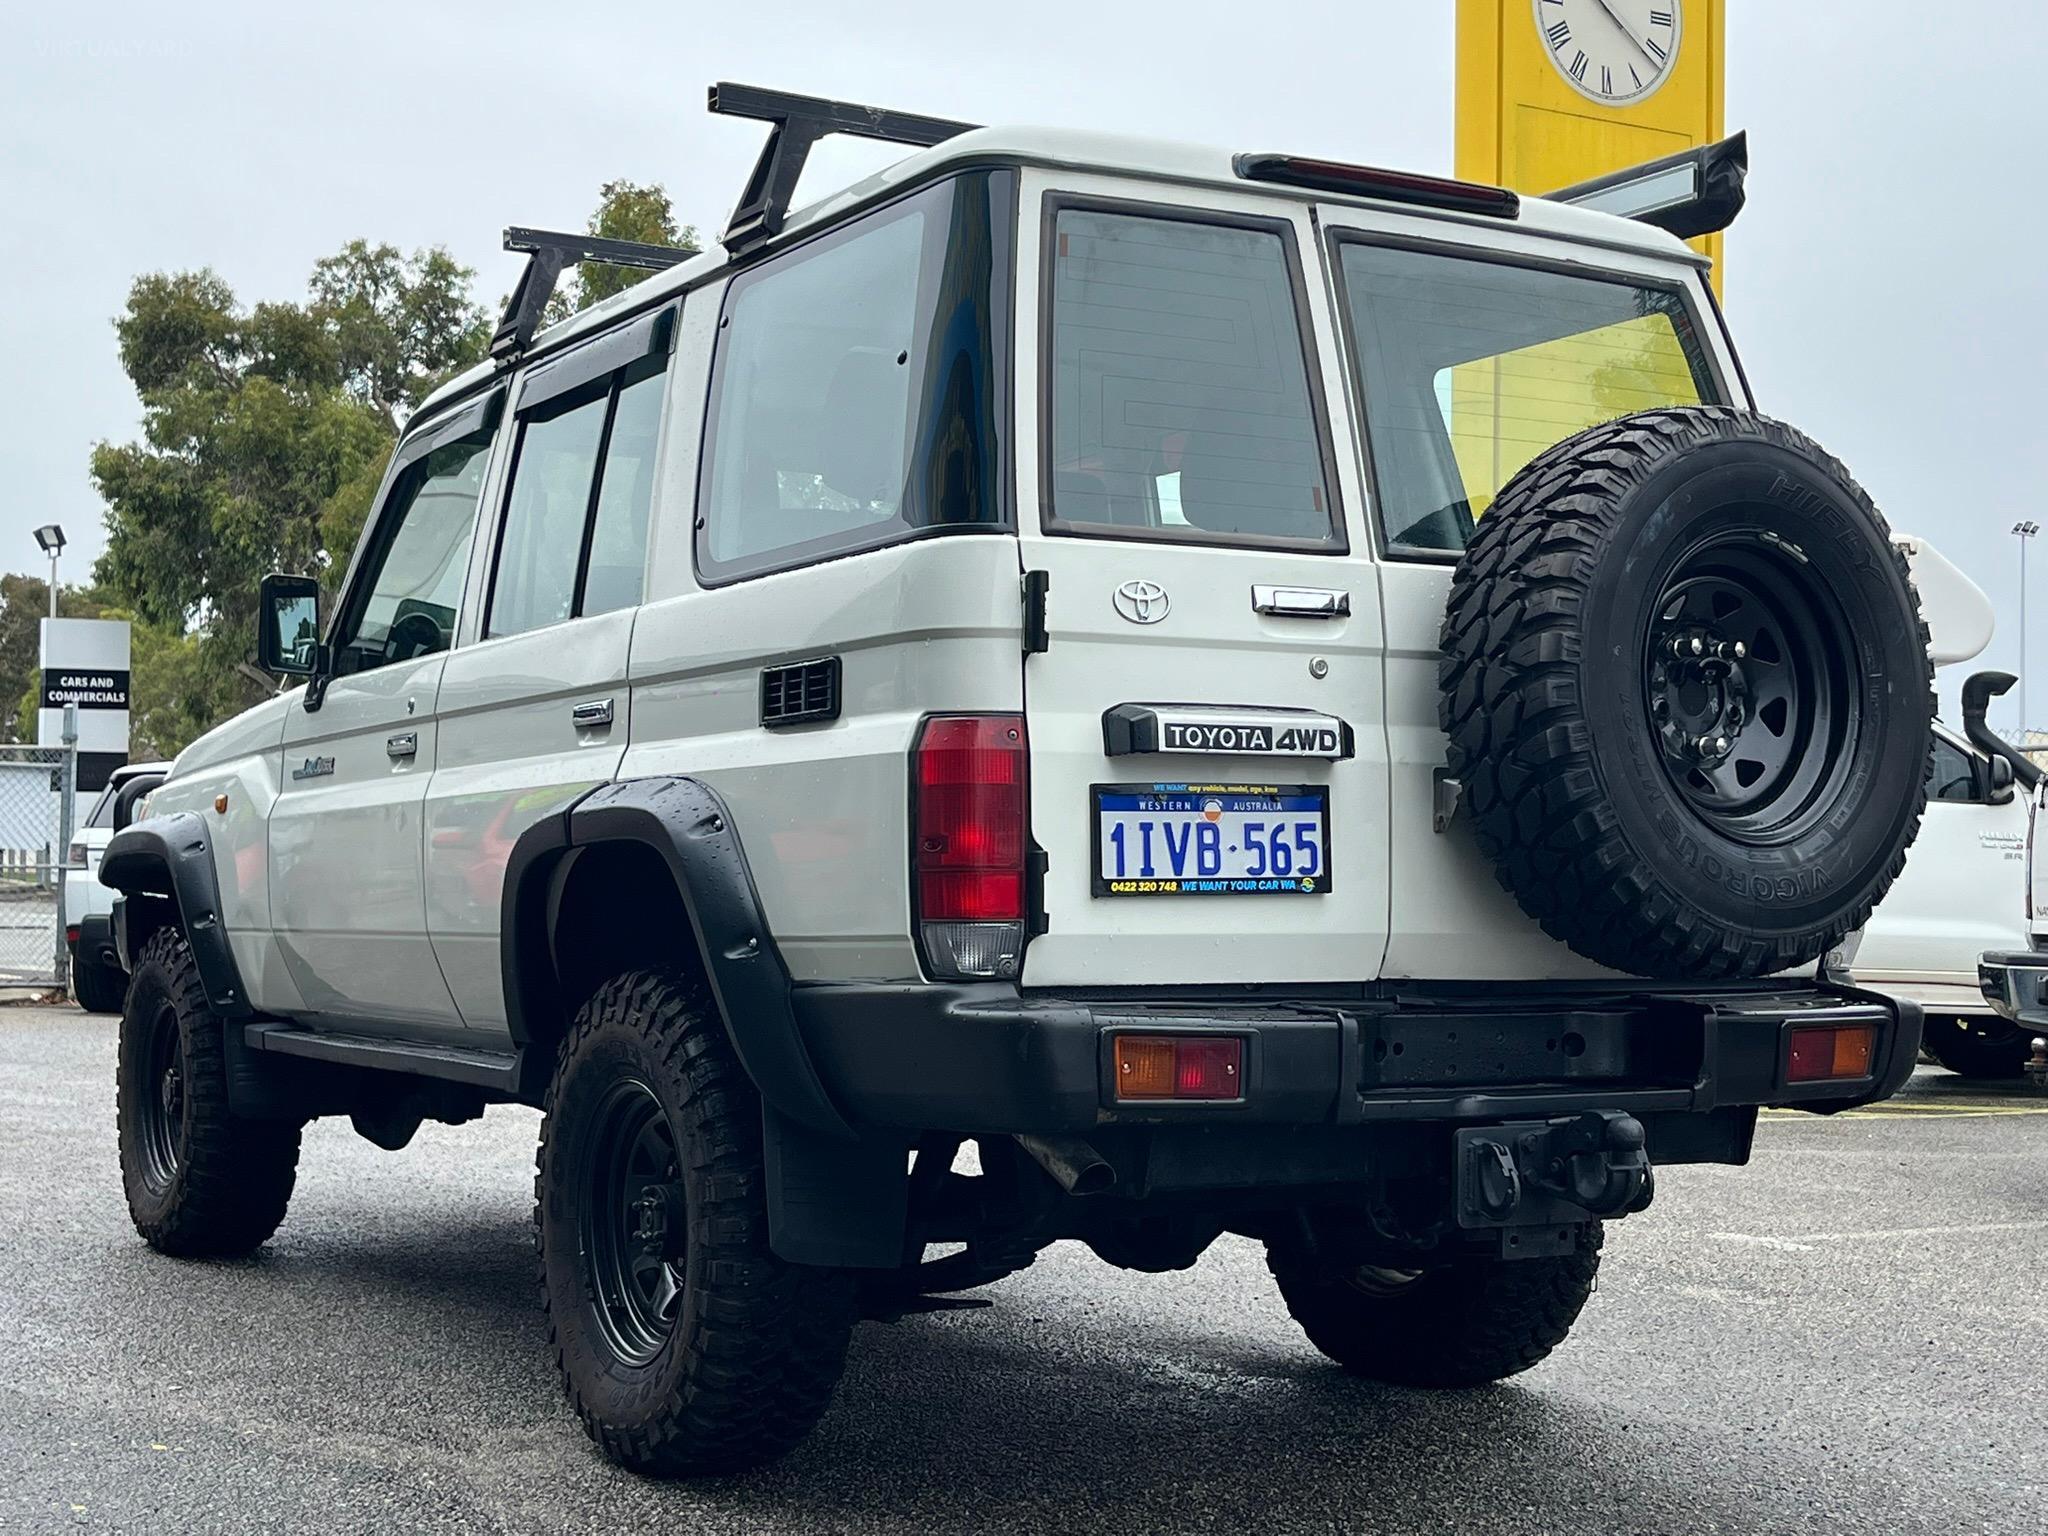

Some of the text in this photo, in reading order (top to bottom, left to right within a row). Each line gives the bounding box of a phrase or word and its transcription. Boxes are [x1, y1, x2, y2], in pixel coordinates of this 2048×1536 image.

[1765, 474, 1888, 586] HIFLY
[60, 676, 114, 688] CARS AND
[48, 690, 126, 703] COMMERCIALS
[1169, 726, 1338, 751] TOYOTA 4WD
[1139, 801, 1283, 811] WESTERN AUSTRALIA
[1111, 880, 1297, 892] 0422 320 748 WE WANT YOUR CAR WA
